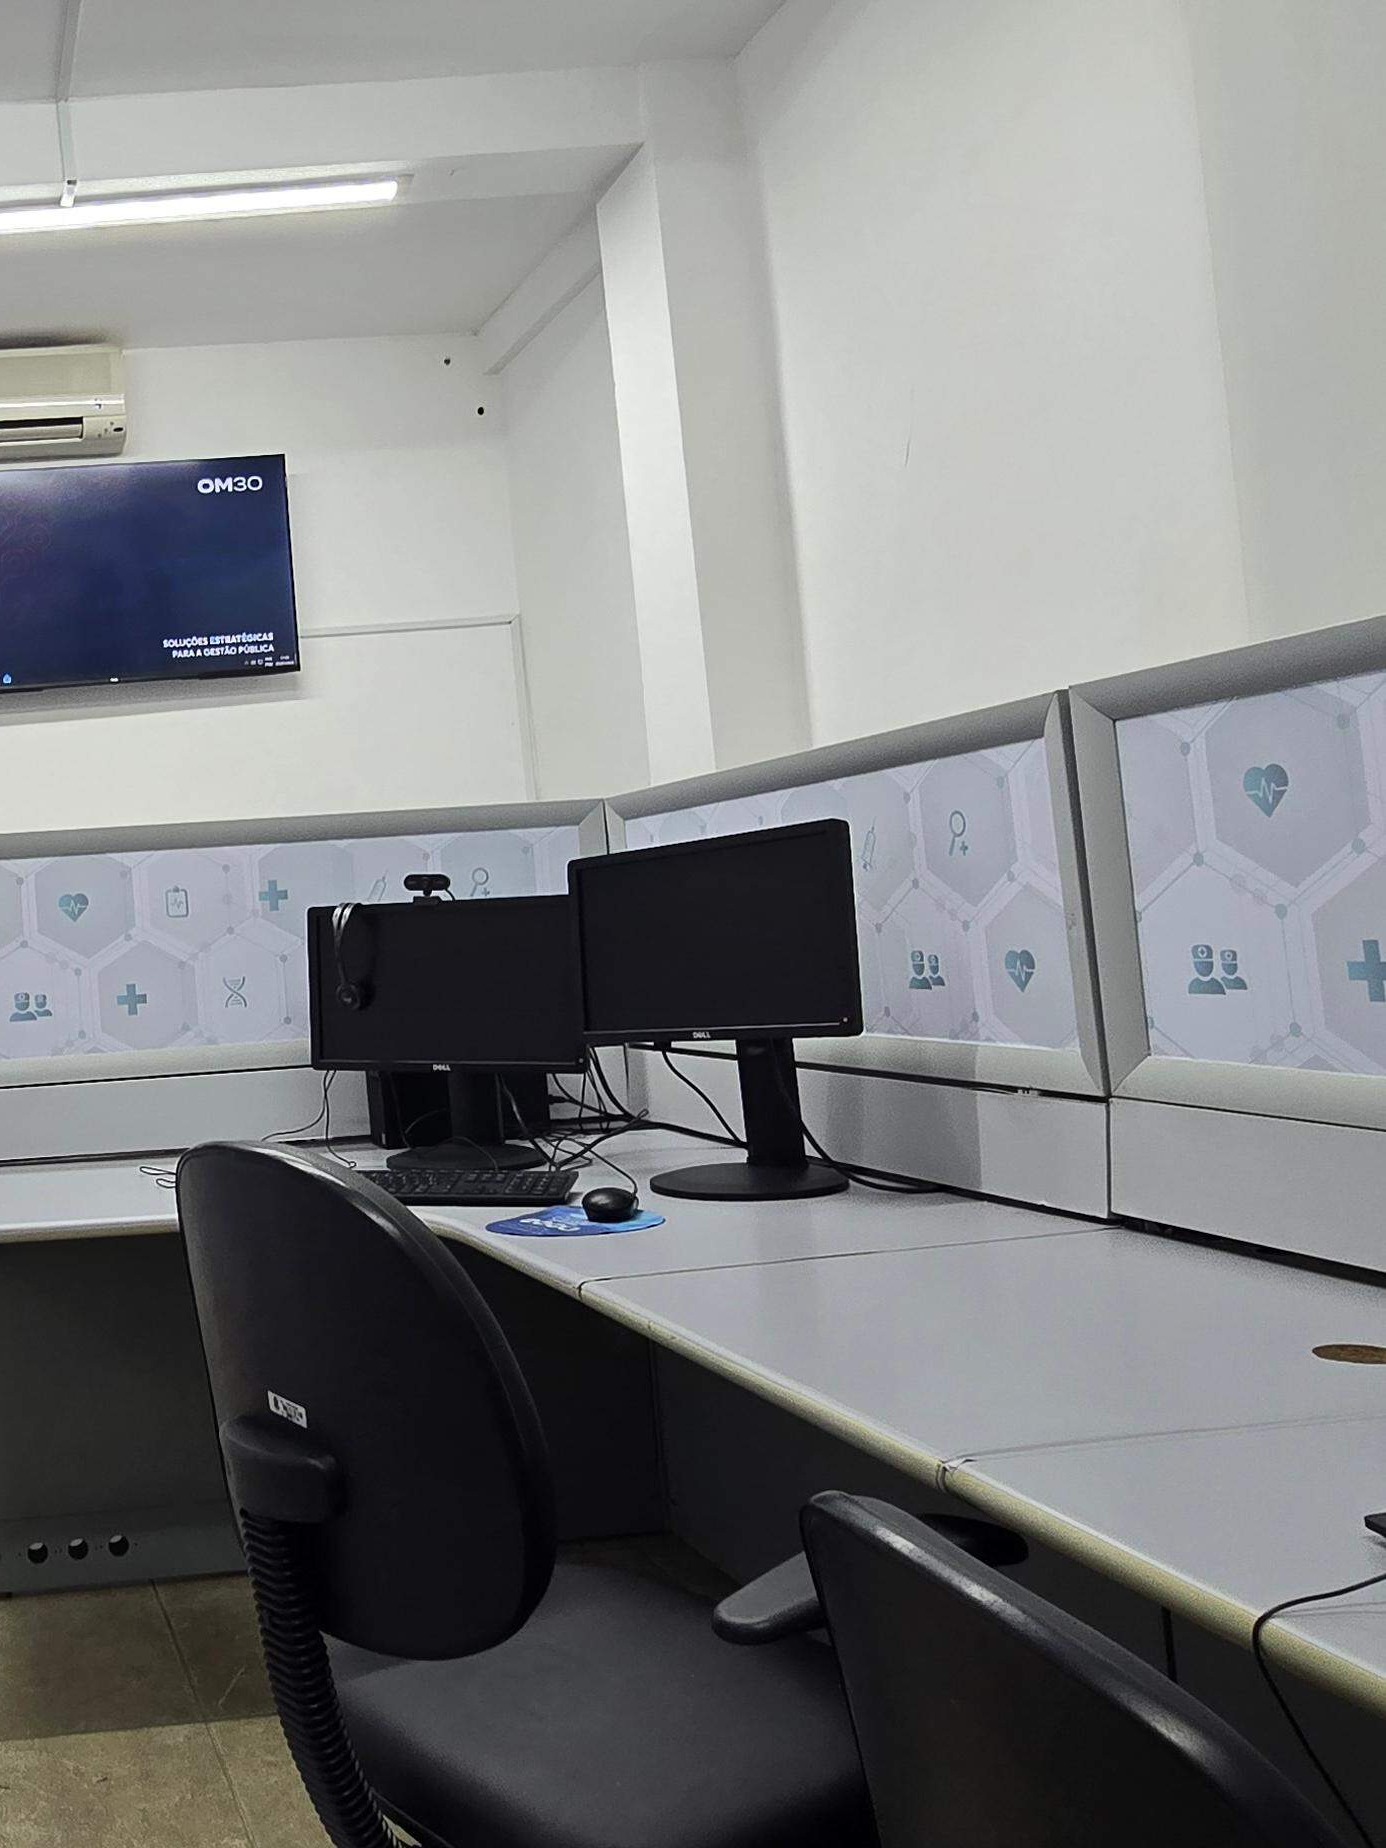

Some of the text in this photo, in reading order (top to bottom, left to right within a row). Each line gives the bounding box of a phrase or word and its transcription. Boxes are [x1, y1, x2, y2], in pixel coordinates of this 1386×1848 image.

[163, 632, 274, 648] SOLUÇÕES ESTRATÉGICAS
[172, 643, 275, 658] PARA A GESTÃO PÚBLICA
[692, 1031, 712, 1039] DELL
[432, 1063, 452, 1072] DELL
